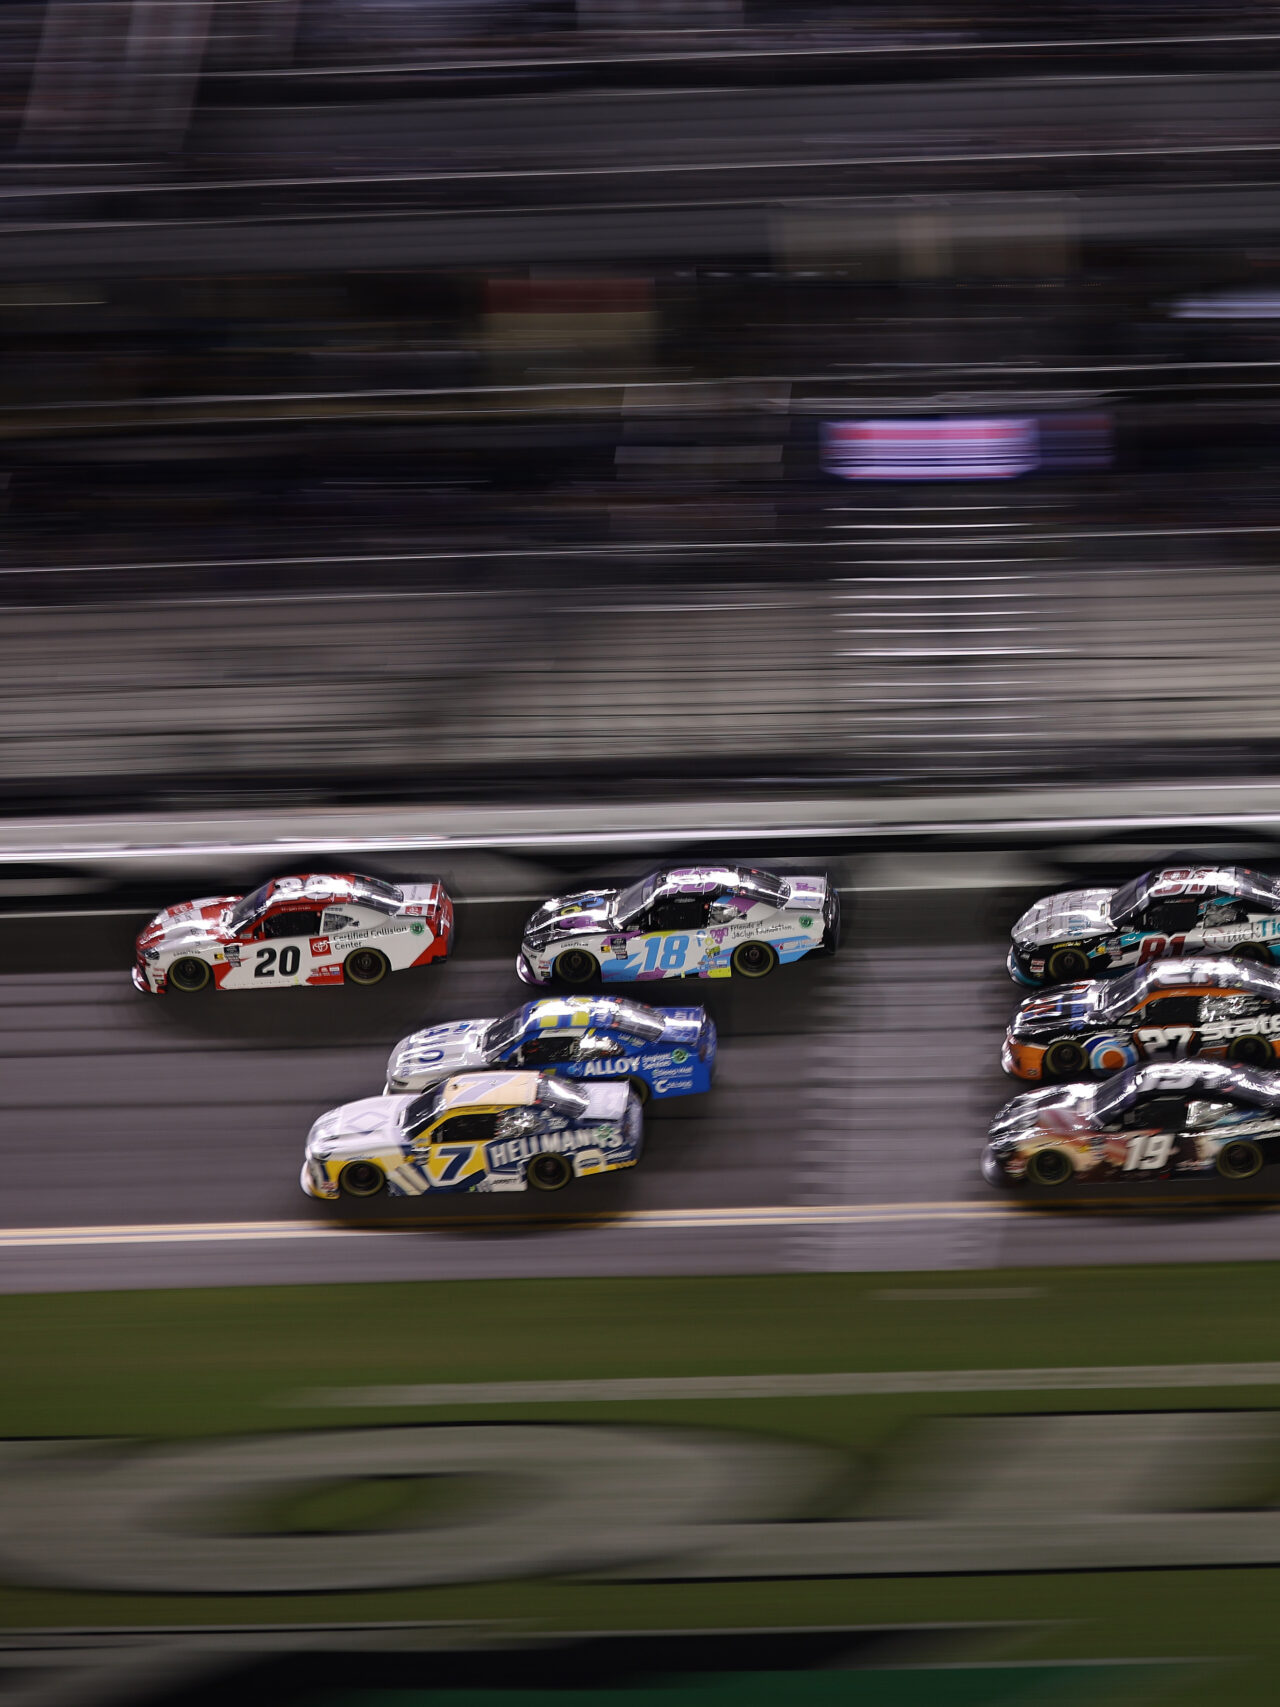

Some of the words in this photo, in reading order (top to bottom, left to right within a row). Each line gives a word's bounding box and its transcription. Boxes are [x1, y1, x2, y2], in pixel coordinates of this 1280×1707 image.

[333, 930, 369, 941] Certified
[334, 941, 362, 950] Center
[254, 945, 300, 978] 20
[642, 935, 690, 972] 18
[1138, 1026, 1193, 1059] 27
[583, 1055, 641, 1077] ALLOY
[437, 1146, 475, 1182] 7
[1122, 1133, 1176, 1171] 19
